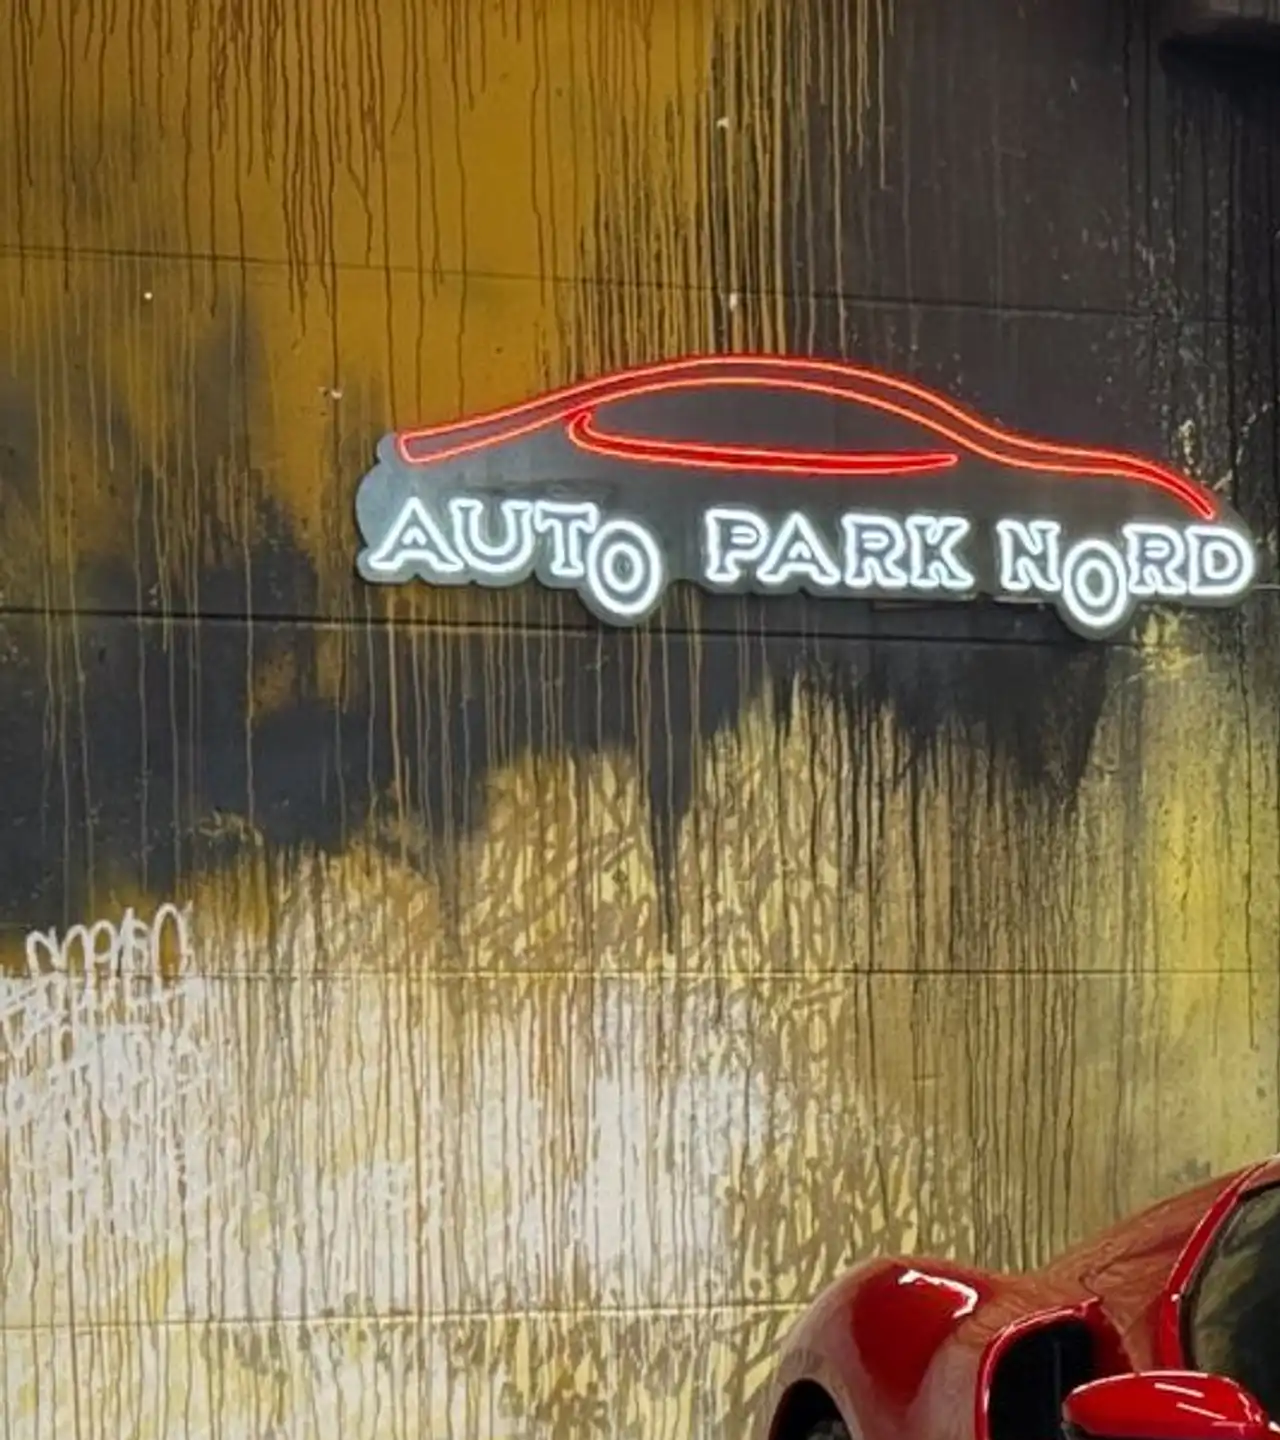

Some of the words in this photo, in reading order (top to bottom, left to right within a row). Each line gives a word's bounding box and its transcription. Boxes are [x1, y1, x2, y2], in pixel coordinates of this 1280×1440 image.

[370, 498, 661, 620] AUTO
[704, 508, 975, 588] PARK
[999, 520, 1255, 628] NORD
